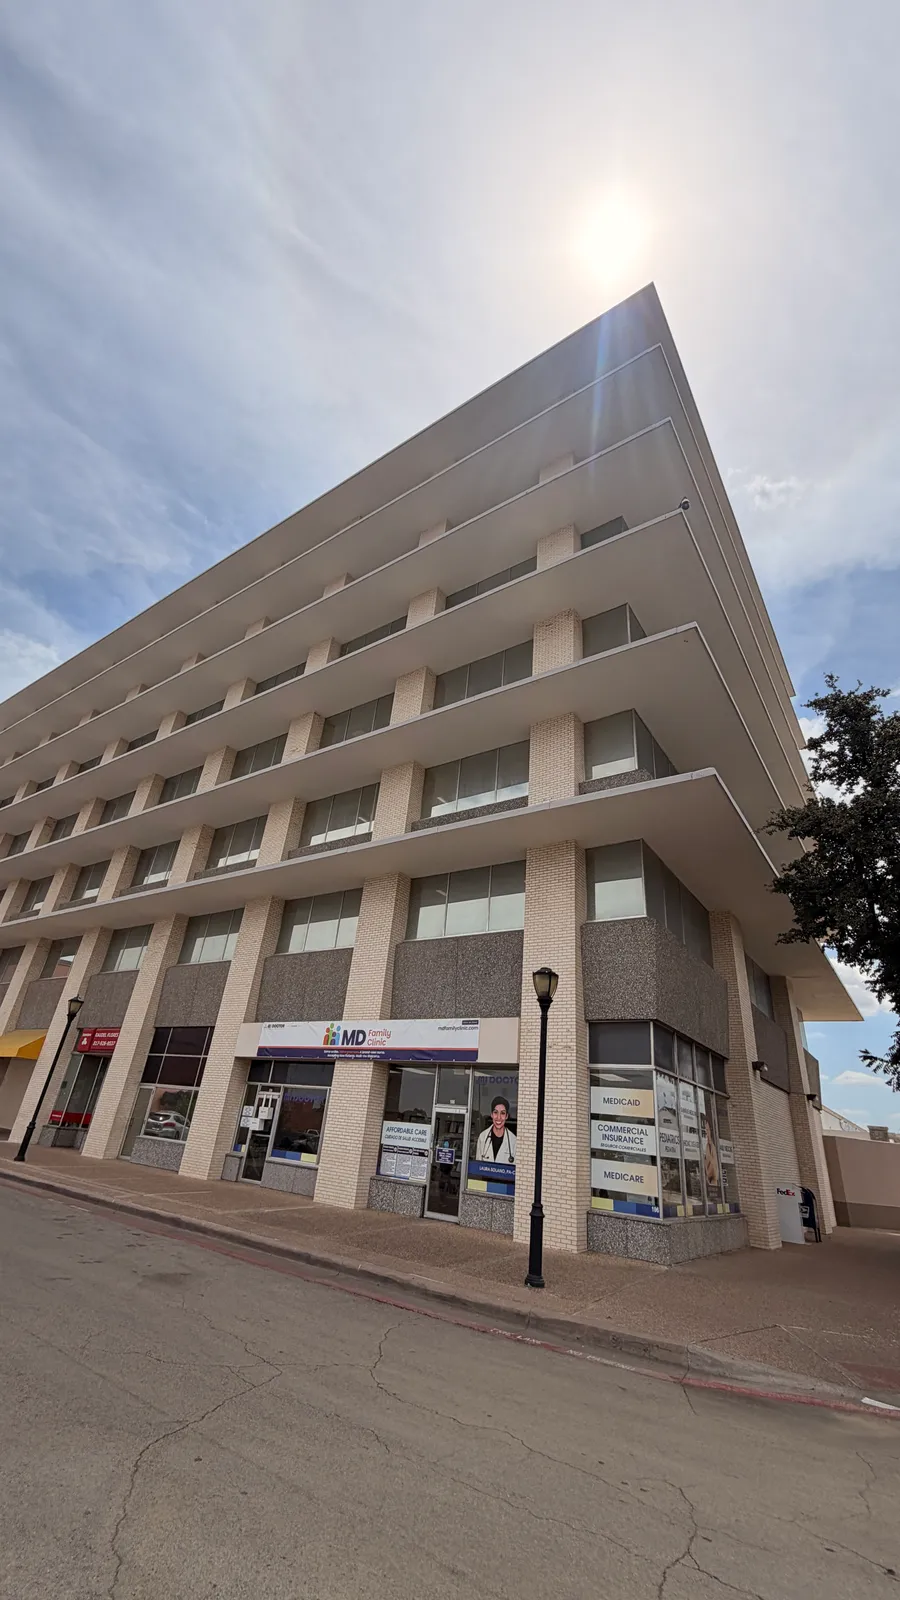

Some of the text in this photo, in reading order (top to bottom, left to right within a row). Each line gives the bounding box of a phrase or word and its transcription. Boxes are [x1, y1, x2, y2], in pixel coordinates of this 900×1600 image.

[341, 1029, 366, 1046] MD
[368, 1028, 391, 1039] Family
[367, 1038, 387, 1046] Clinic
[602, 1097, 641, 1107] MEDICAID
[386, 1126, 427, 1136] AFFORDABLE CARE
[597, 1124, 649, 1137] COMMERCIAL
[601, 1133, 644, 1145] INSURANCE
[659, 1132, 680, 1145] PEDIATRICS
[618, 1144, 647, 1153] COMERCIALES
[603, 1171, 644, 1184] MEDICARE
[776, 1187, 796, 1197] FedEx
